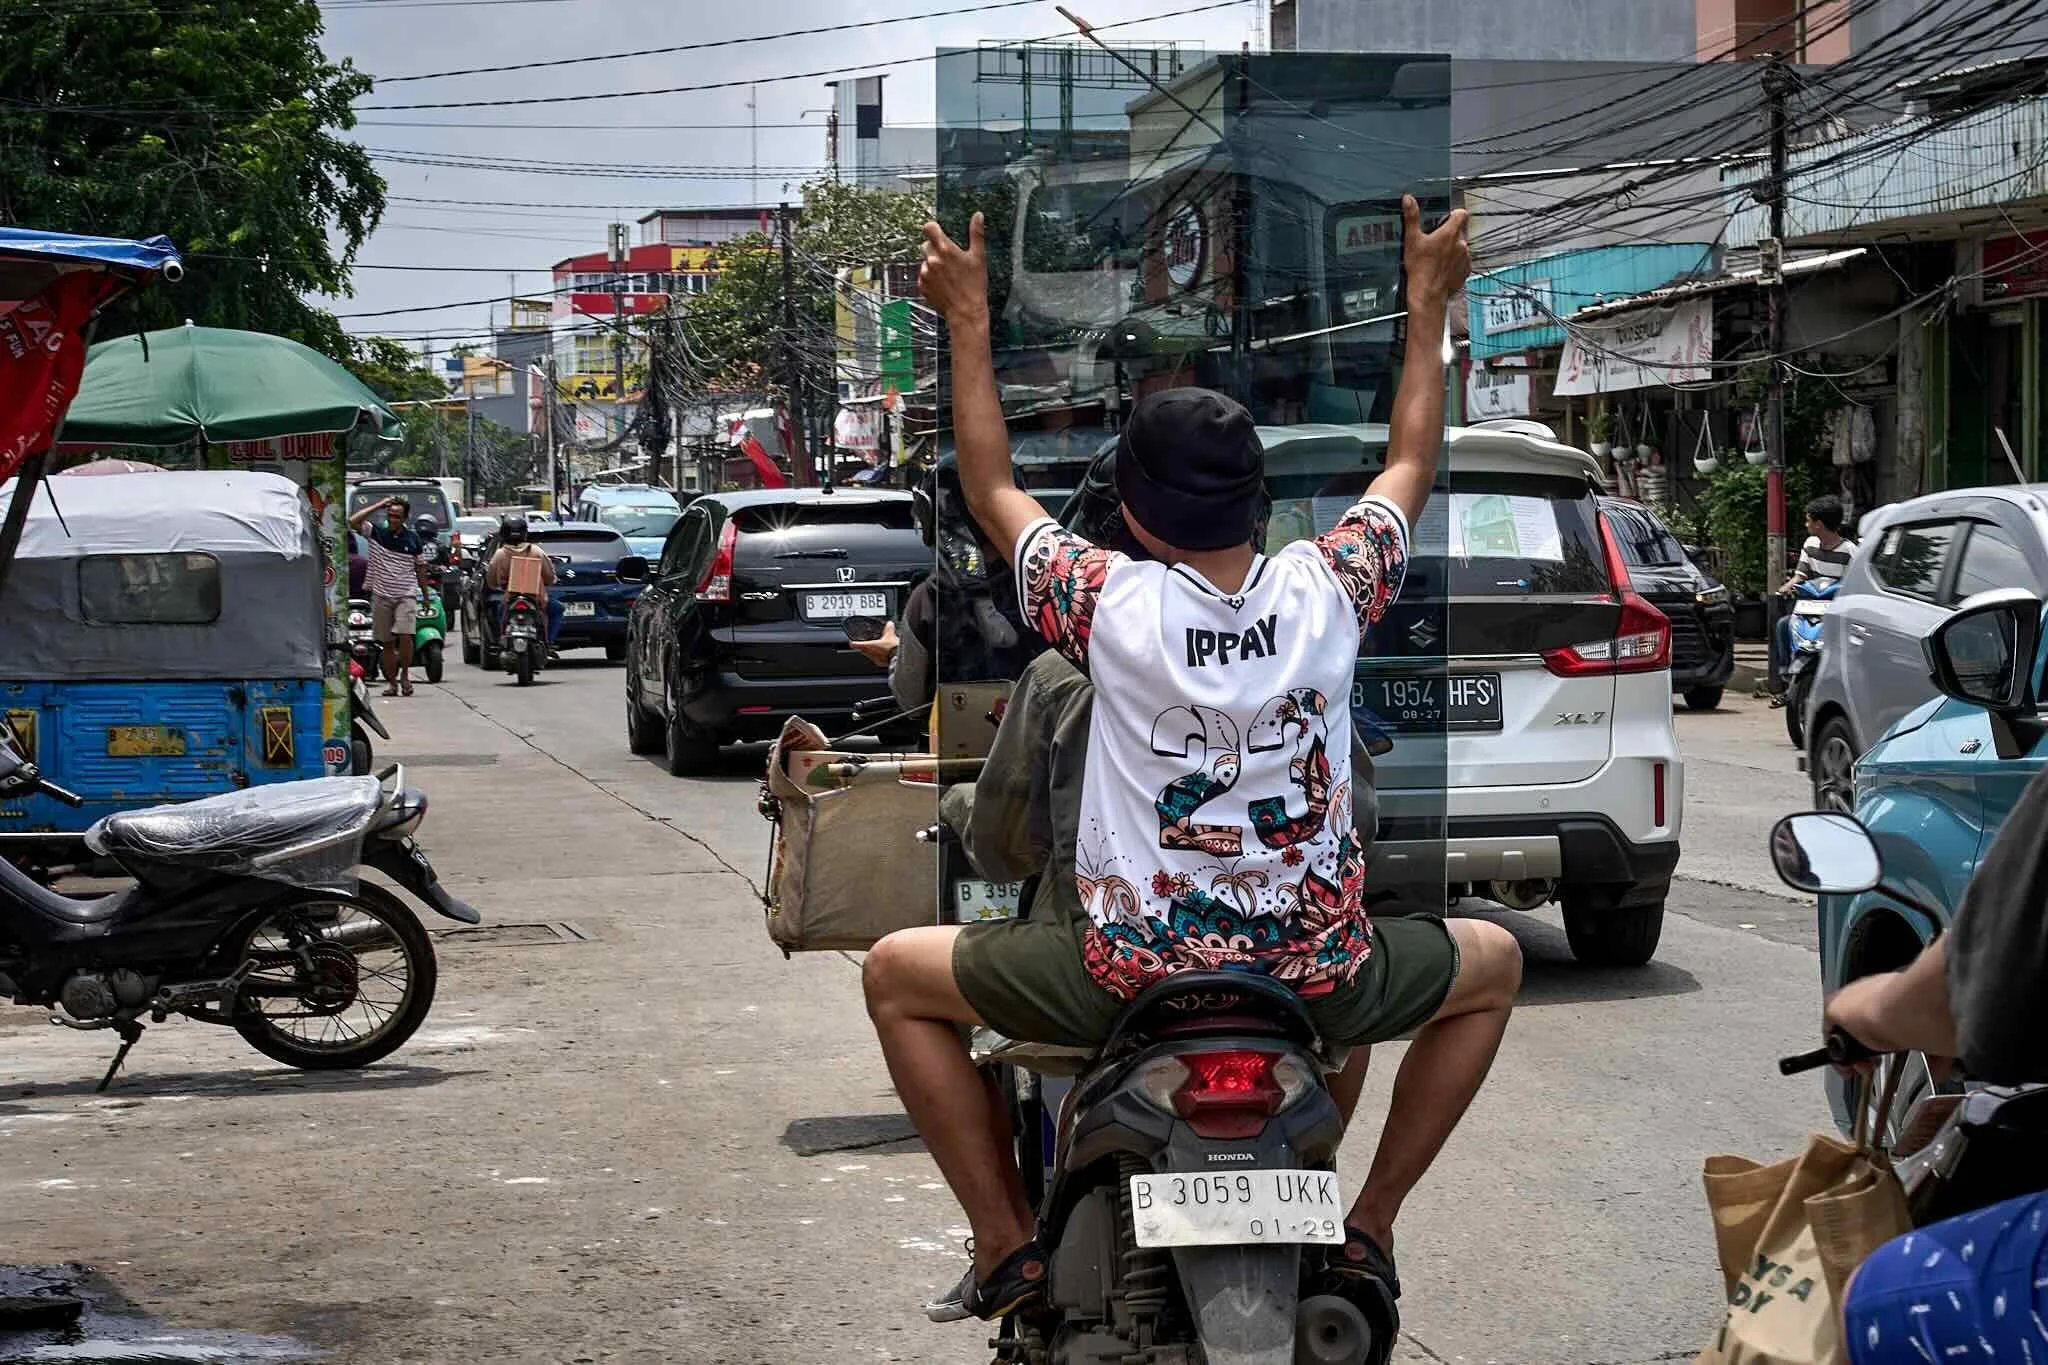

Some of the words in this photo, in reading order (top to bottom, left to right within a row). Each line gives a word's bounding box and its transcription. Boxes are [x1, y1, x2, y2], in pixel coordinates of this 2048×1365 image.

[807, 597, 815, 610] B
[821, 595, 853, 610] 2919
[860, 594, 885, 609] BBE
[1185, 614, 1280, 667] IPPAY
[1352, 682, 1364, 708] B
[1381, 680, 1435, 707] 1954
[1448, 679, 1491, 706] HFS
[1553, 711, 1606, 727] XL7
[1150, 687, 1332, 857] 23
[961, 883, 973, 901] B
[983, 882, 1020, 898] 396
[1207, 1152, 1255, 1162] HONDA
[1136, 1181, 1153, 1209] B
[1173, 1175, 1251, 1205] 3059
[1277, 1175, 1335, 1205] UKK
